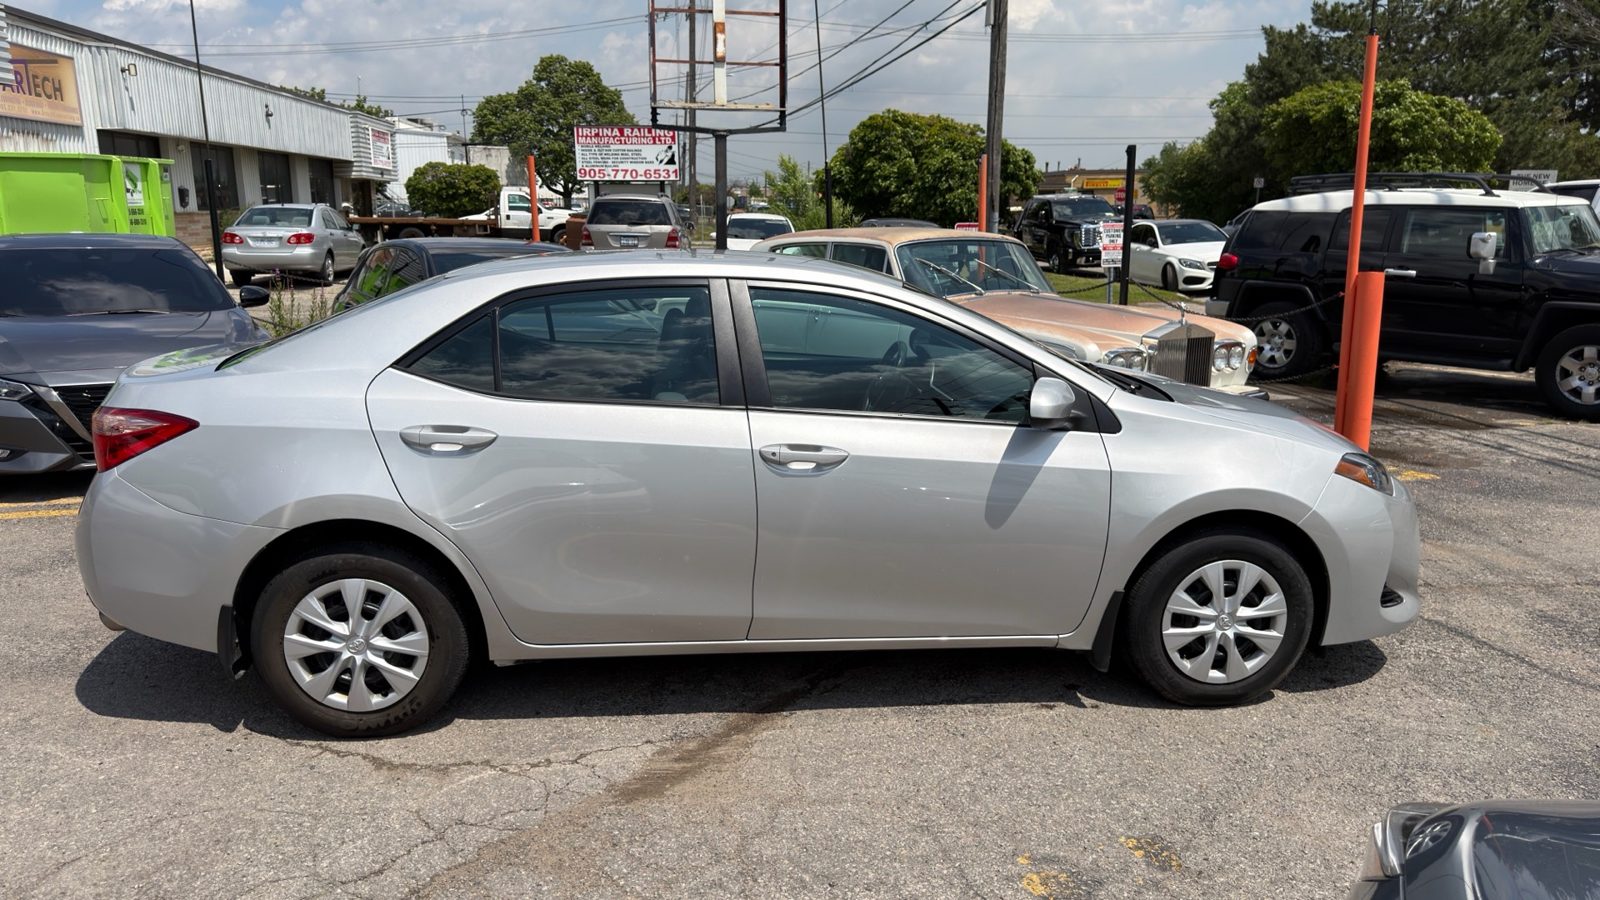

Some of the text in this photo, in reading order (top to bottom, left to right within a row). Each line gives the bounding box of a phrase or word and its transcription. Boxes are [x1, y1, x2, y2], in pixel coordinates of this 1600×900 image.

[578, 128, 674, 137] IRPINA RAILING
[578, 168, 678, 179] 905-770-6531
